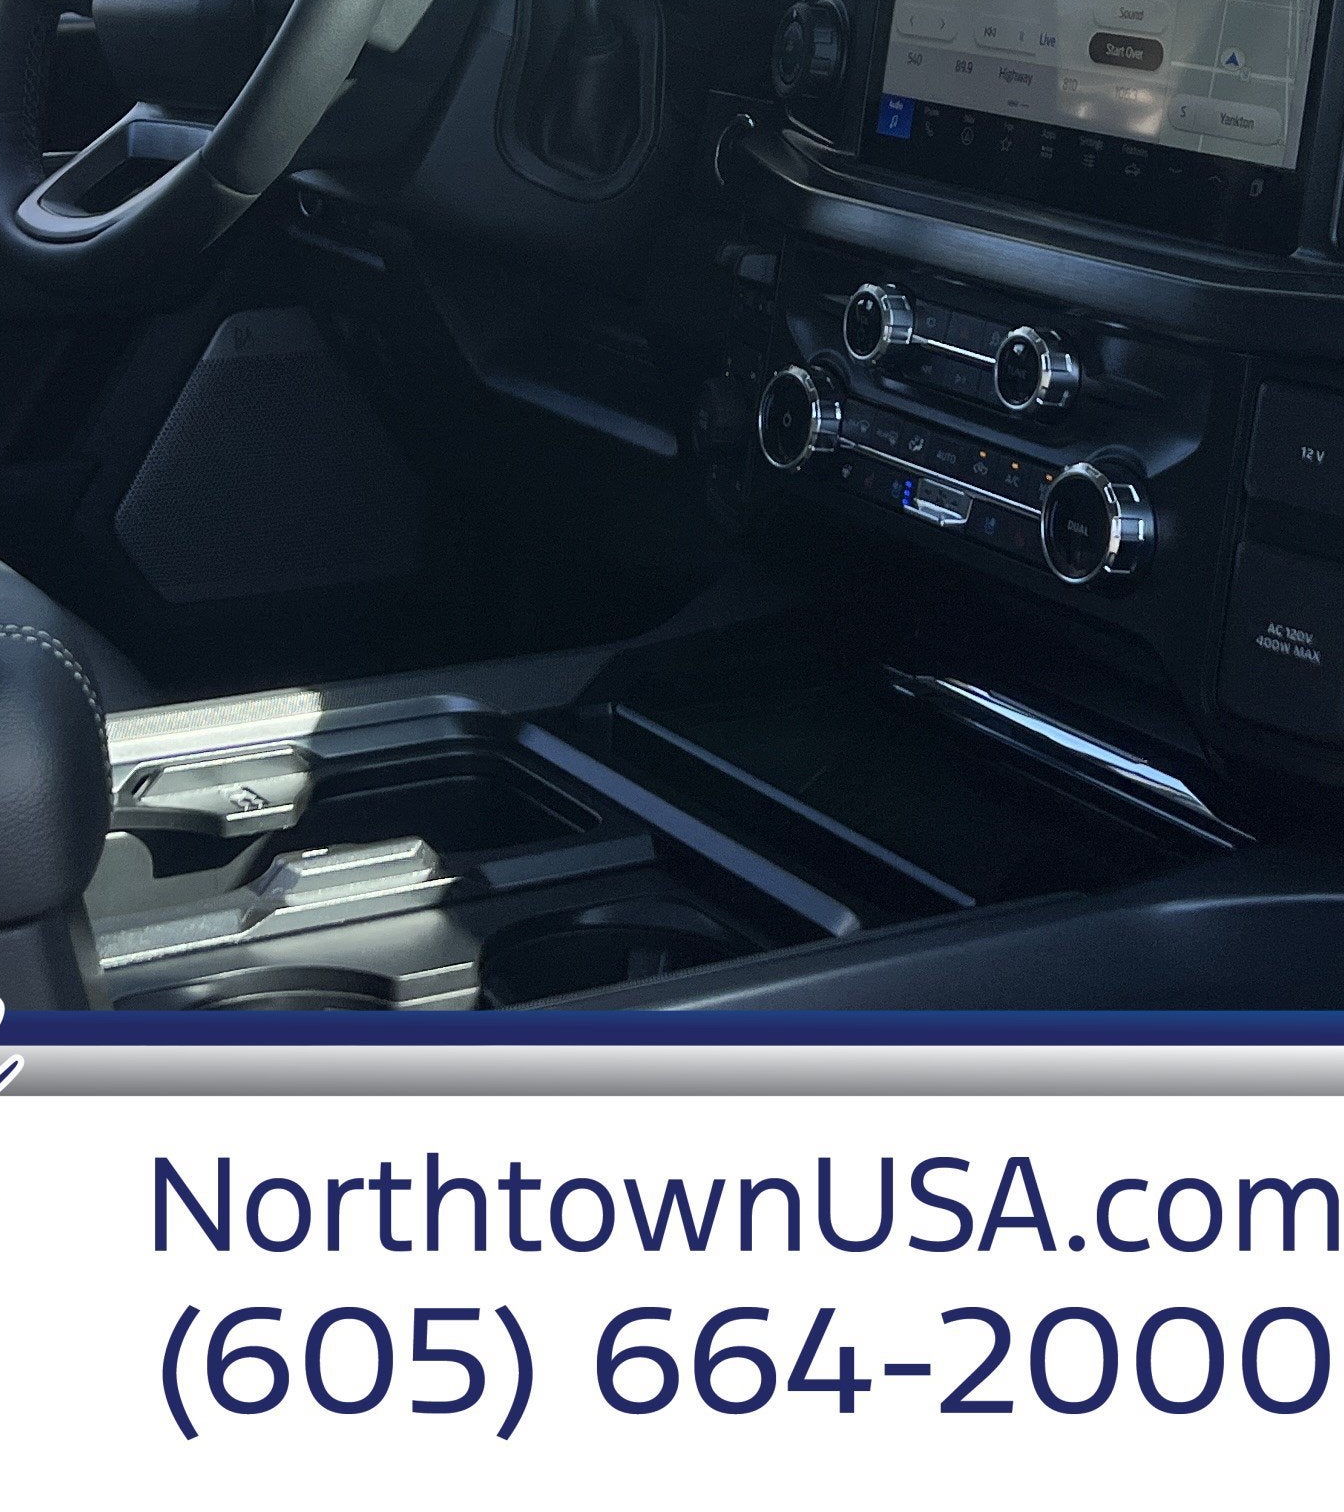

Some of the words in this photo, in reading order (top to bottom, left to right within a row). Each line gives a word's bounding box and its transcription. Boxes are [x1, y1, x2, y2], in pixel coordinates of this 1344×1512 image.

[1039, 32, 1056, 47] Live
[1106, 43, 1125, 57] Start
[1126, 46, 1143, 60] Over
[1220, 112, 1254, 129] Yankton
[1066, 519, 1090, 538] DUAL
[1266, 621, 1283, 636] AC
[1285, 626, 1315, 644] 120V
[1255, 634, 1290, 655] 400W
[1292, 642, 1322, 665] MAX
